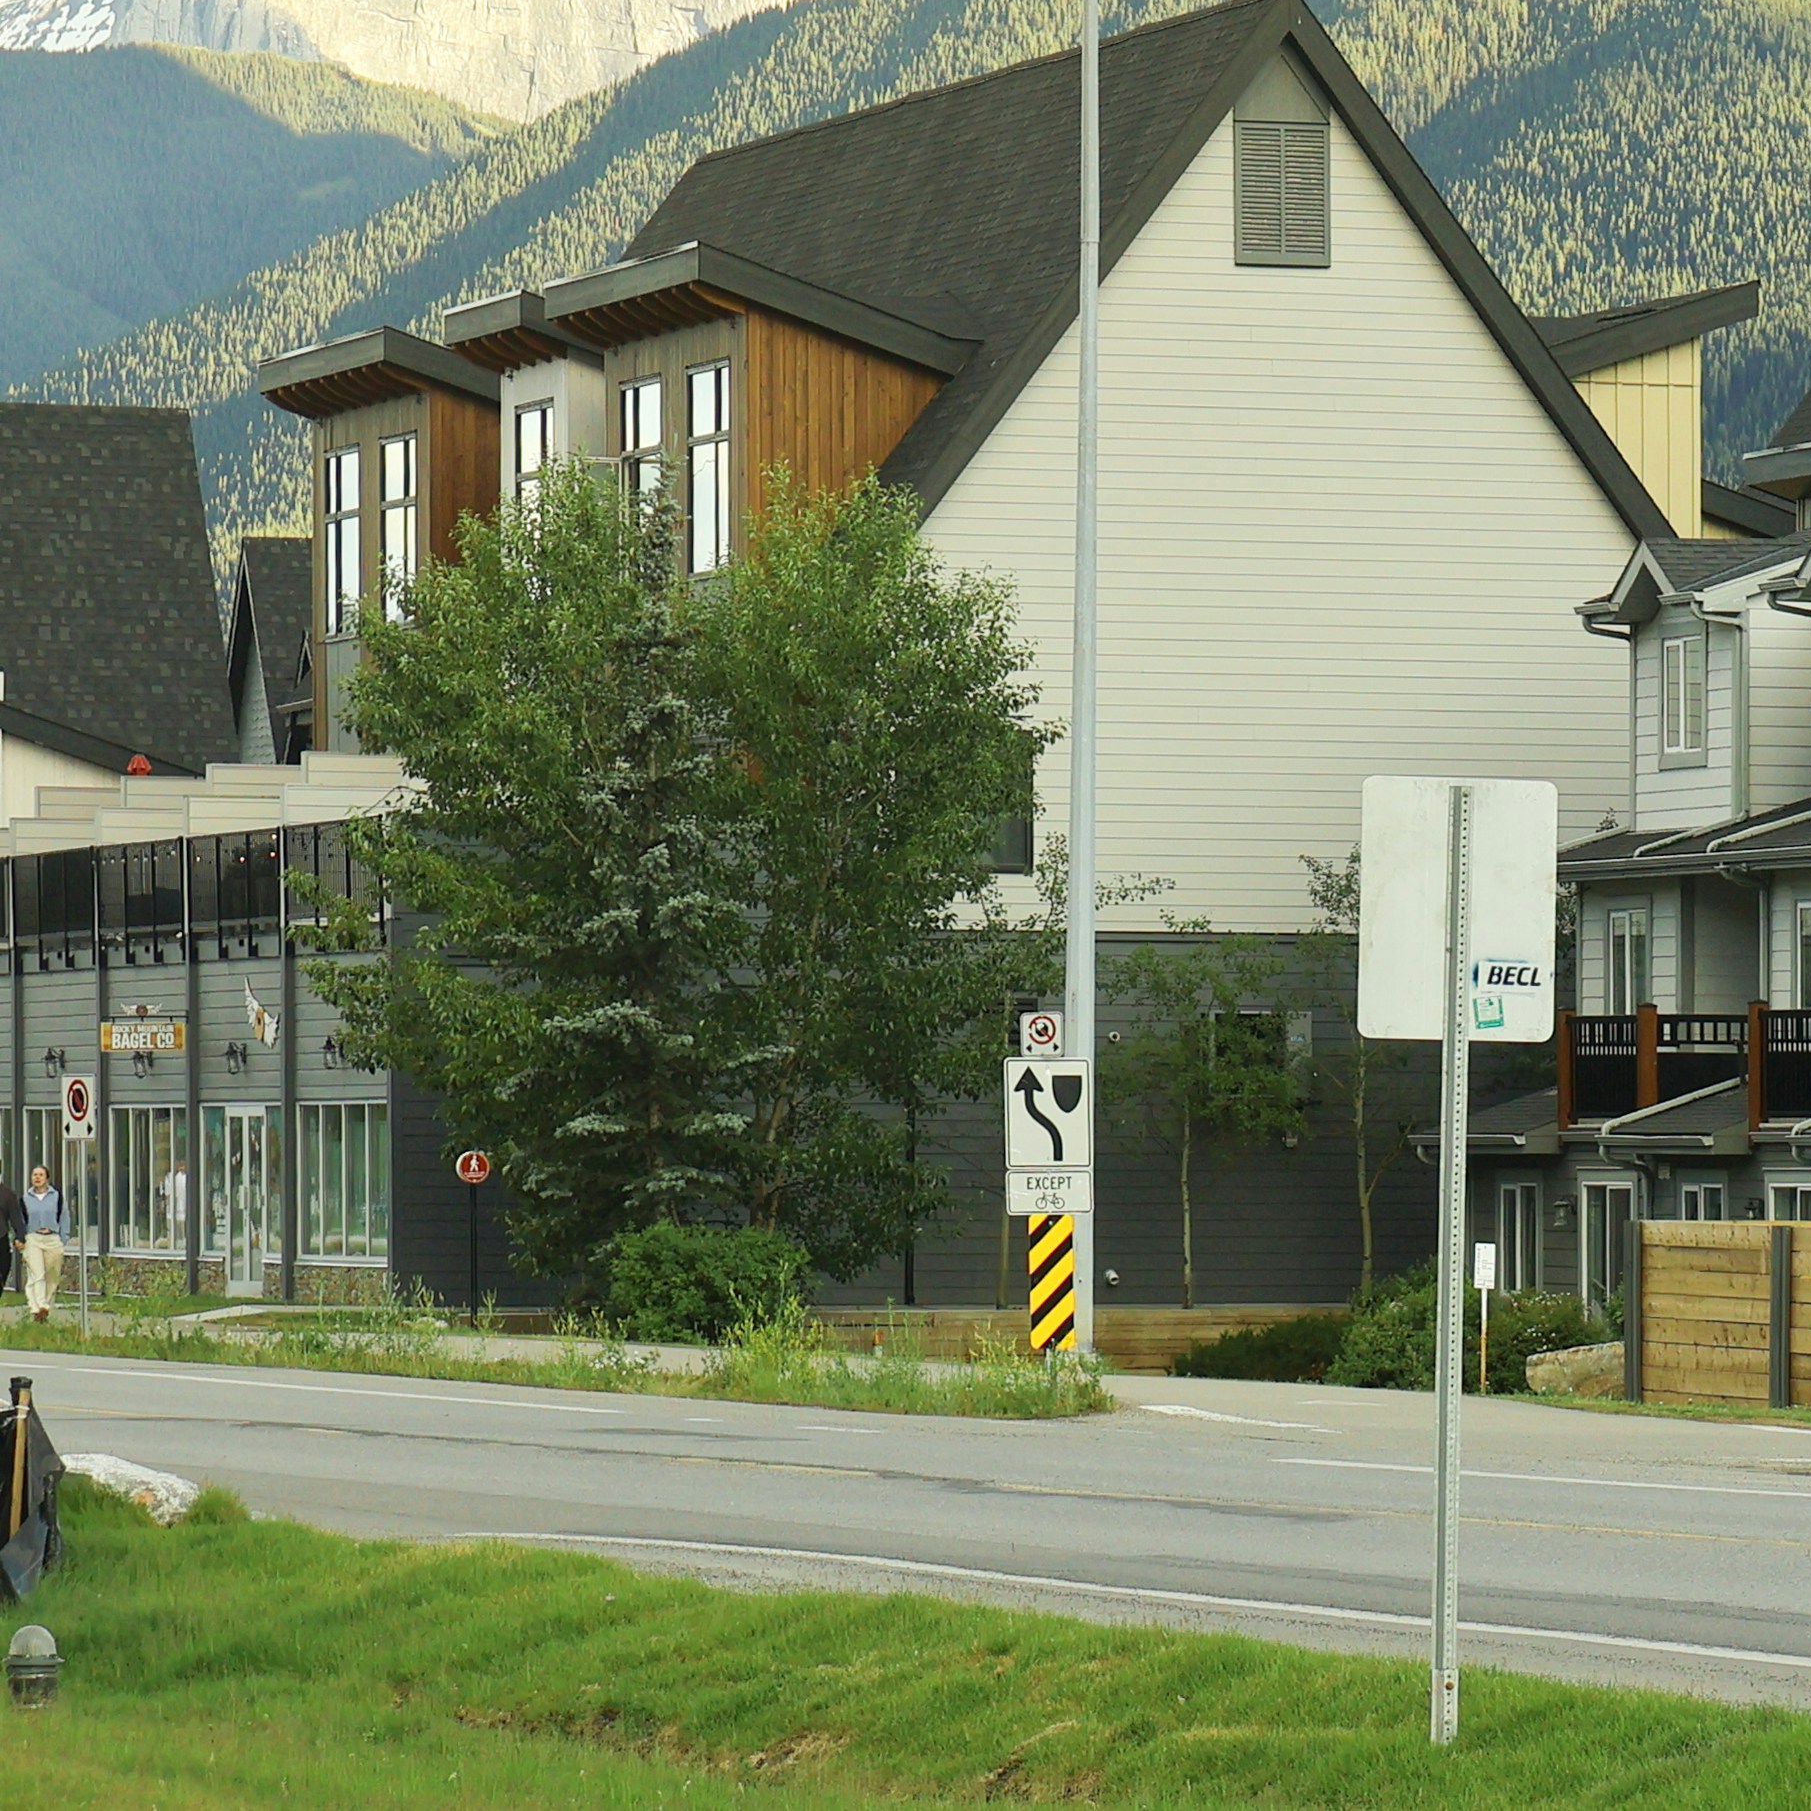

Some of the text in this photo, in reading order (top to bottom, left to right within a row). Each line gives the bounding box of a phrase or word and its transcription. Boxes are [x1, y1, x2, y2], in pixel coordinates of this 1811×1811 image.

[1487, 966, 1542, 987] BECL
[112, 1033, 155, 1049] BAGEL
[1026, 1176, 1072, 1190] EXCEPT
